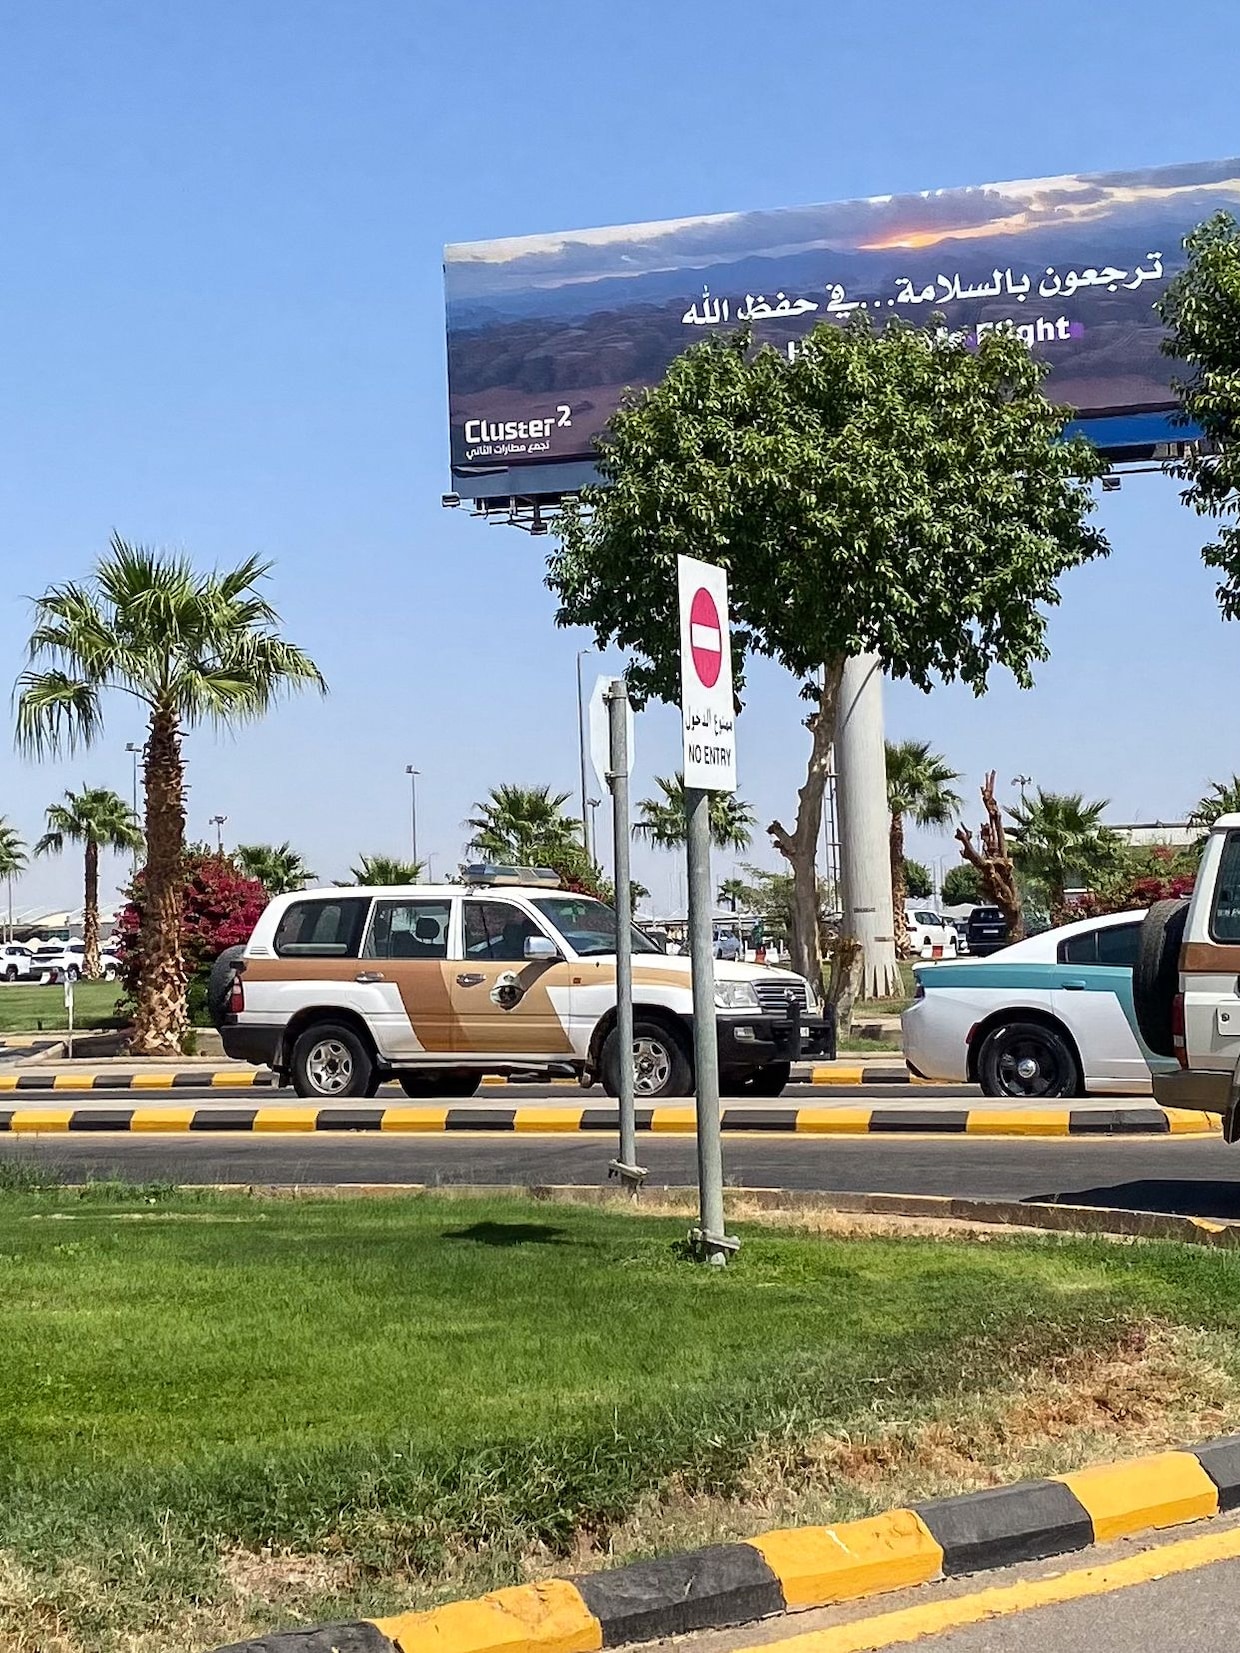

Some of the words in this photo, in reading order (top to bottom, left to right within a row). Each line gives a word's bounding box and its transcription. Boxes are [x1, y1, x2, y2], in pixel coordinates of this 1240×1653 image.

[1038, 251, 1164, 297] ترجعون
[736, 291, 819, 321] حفظ
[493, 443, 526, 456] مطارات
[527, 440, 550, 454] تجمع
[688, 743, 702, 764] NO
[704, 745, 732, 767] ENTRY
